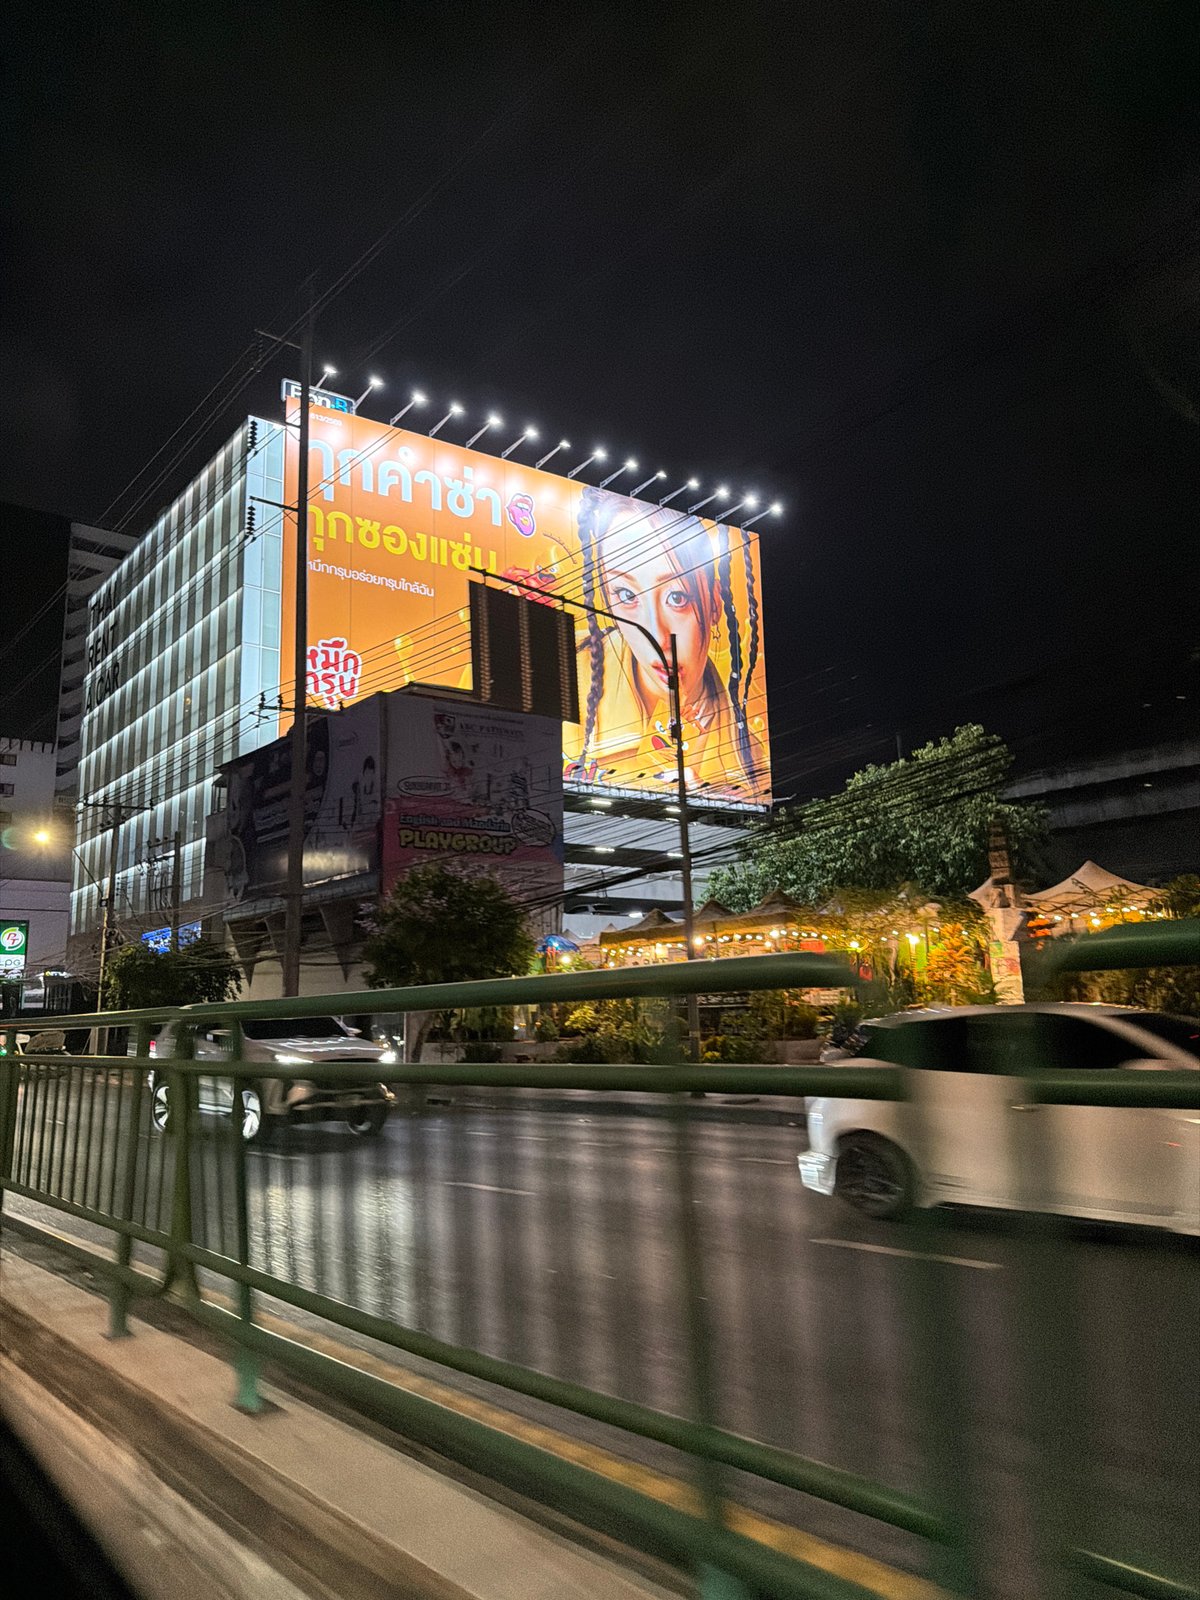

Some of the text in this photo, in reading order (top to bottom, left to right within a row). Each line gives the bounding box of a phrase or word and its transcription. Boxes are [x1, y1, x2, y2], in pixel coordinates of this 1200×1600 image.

[89, 621, 117, 671] RENT
[96, 661, 120, 706] CAR
[400, 828, 518, 855] PLAYGROUP
